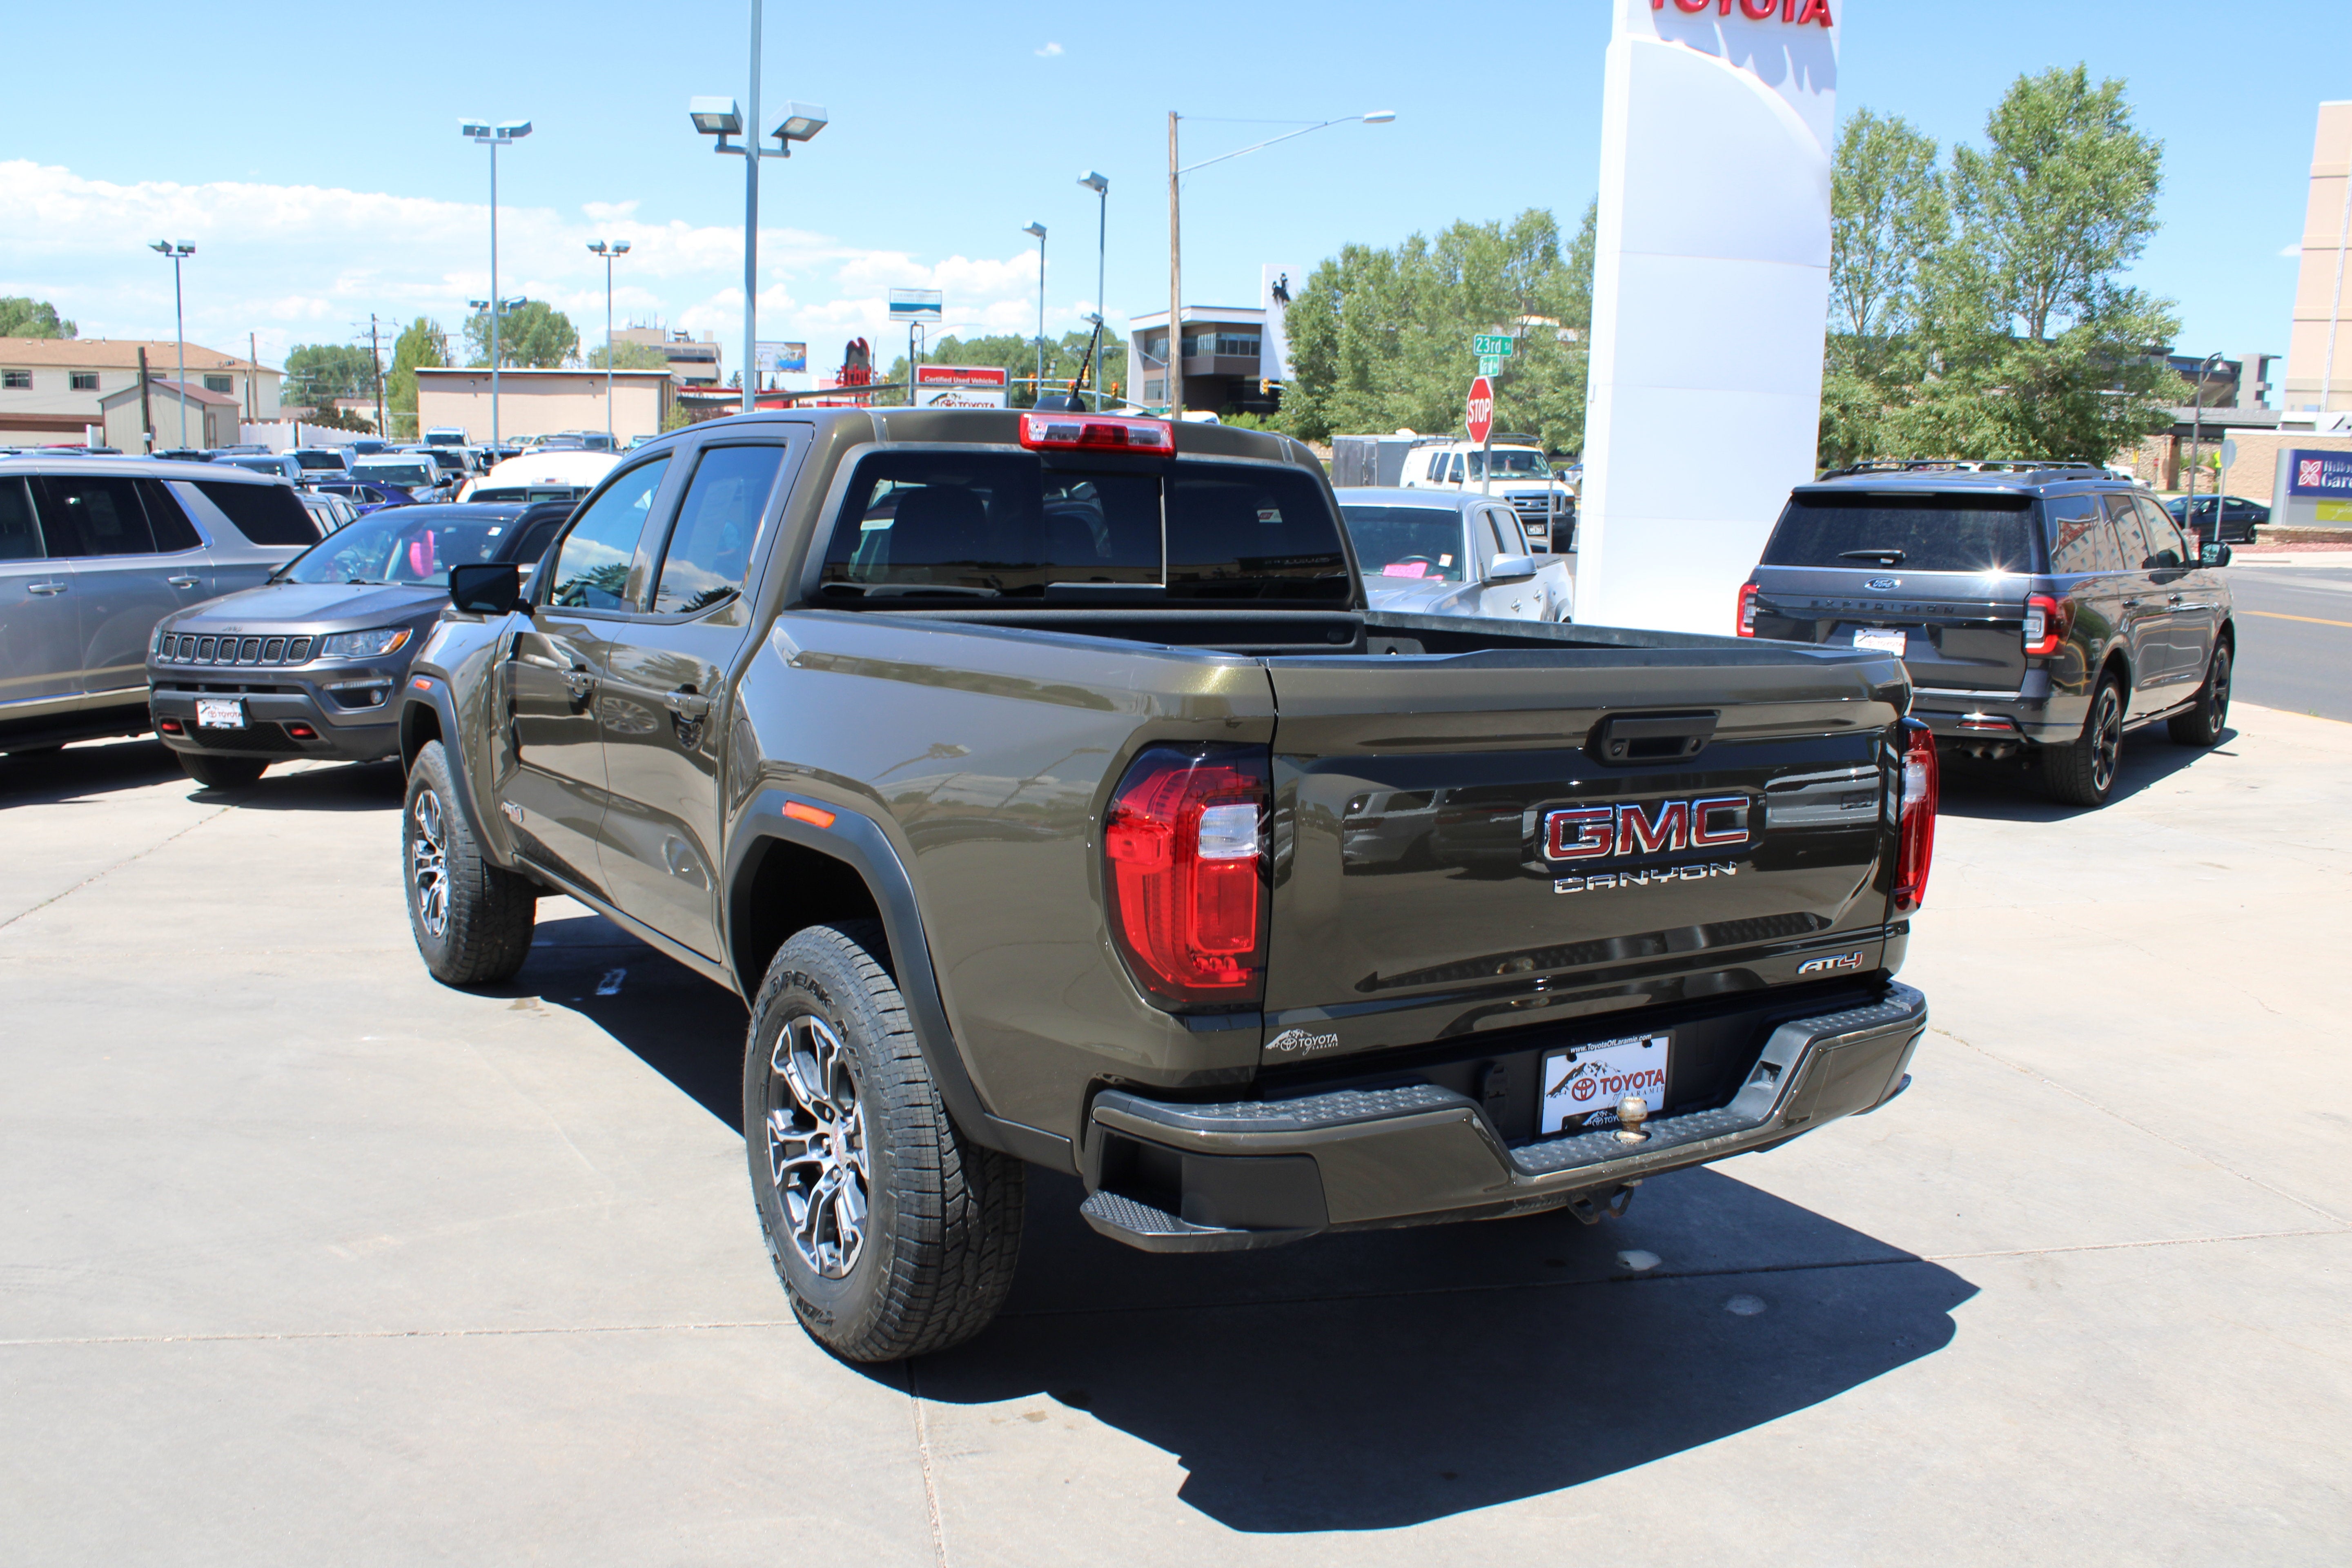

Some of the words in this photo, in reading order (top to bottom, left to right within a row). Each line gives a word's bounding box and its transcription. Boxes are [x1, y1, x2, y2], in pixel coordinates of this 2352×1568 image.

[1476, 337, 1501, 353] 23rd
[1469, 398, 1490, 423] STOP
[1872, 579, 1893, 588] Ford
[1811, 599, 1954, 614] EXPEDITION
[1544, 797, 1749, 861] GMC
[1554, 861, 1737, 894] CANYON
[1798, 951, 1862, 974] AT4
[1299, 1033, 1338, 1047] TOYOTA
[1570, 1034, 1651, 1053] www.ToyotaOfLaramie.com
[1600, 1069, 1665, 1094] TOYOTA
[1608, 1088, 1625, 1108] of
[1623, 1087, 1664, 1098] LARAMIE
